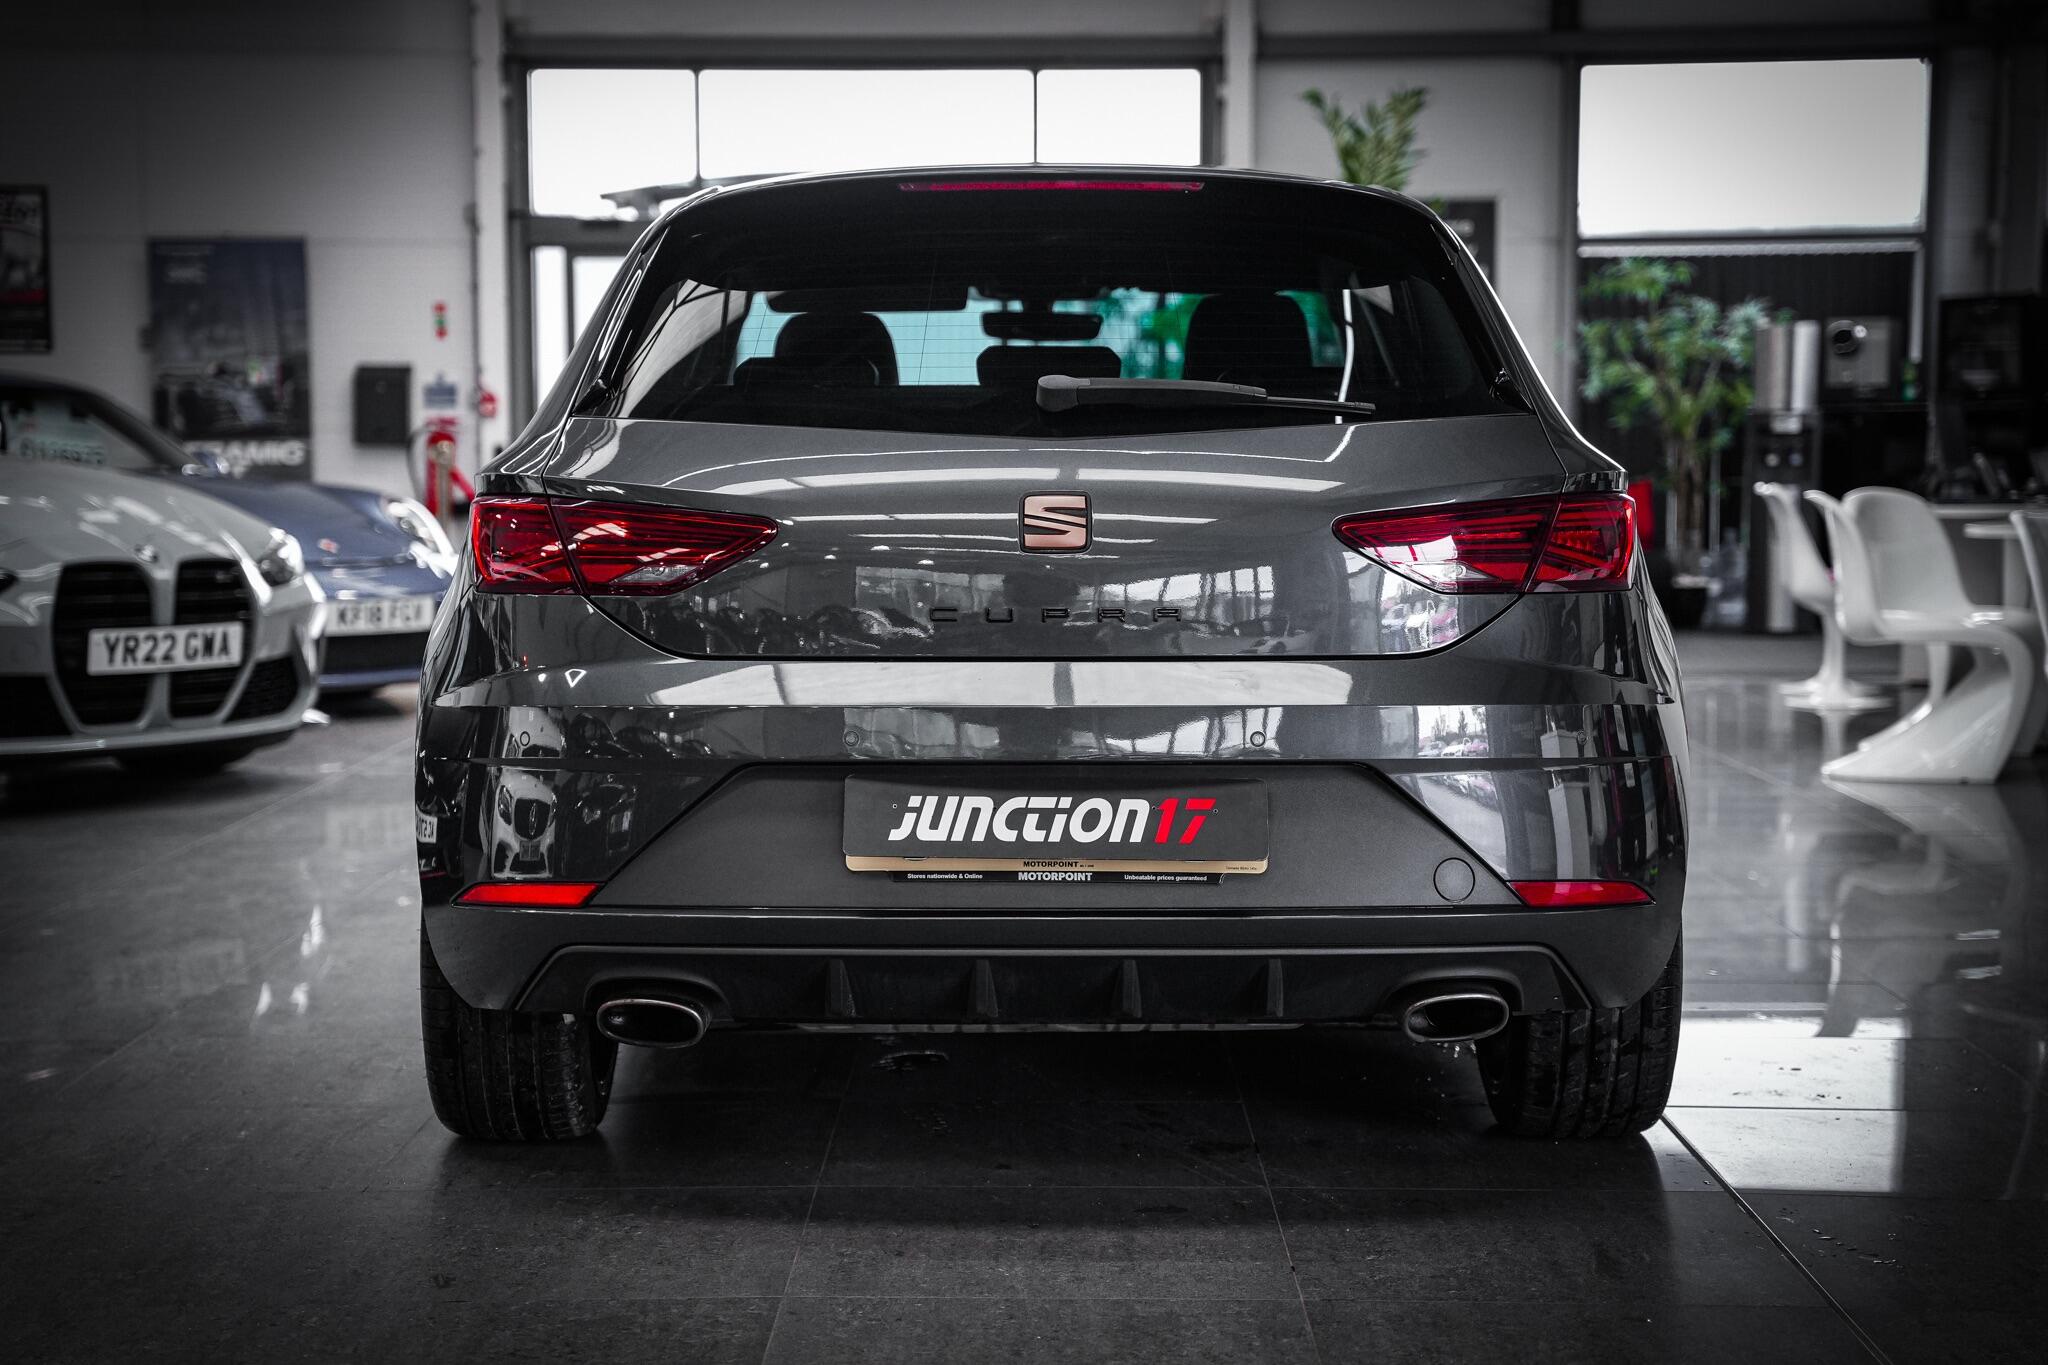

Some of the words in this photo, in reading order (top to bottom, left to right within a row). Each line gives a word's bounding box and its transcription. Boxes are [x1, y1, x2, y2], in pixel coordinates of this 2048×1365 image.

[929, 606, 1182, 624] CUPRA
[104, 633, 176, 666] YR22
[1023, 860, 1079, 868] MOTORPOINT
[1018, 872, 1092, 881] MOTORPOINT
